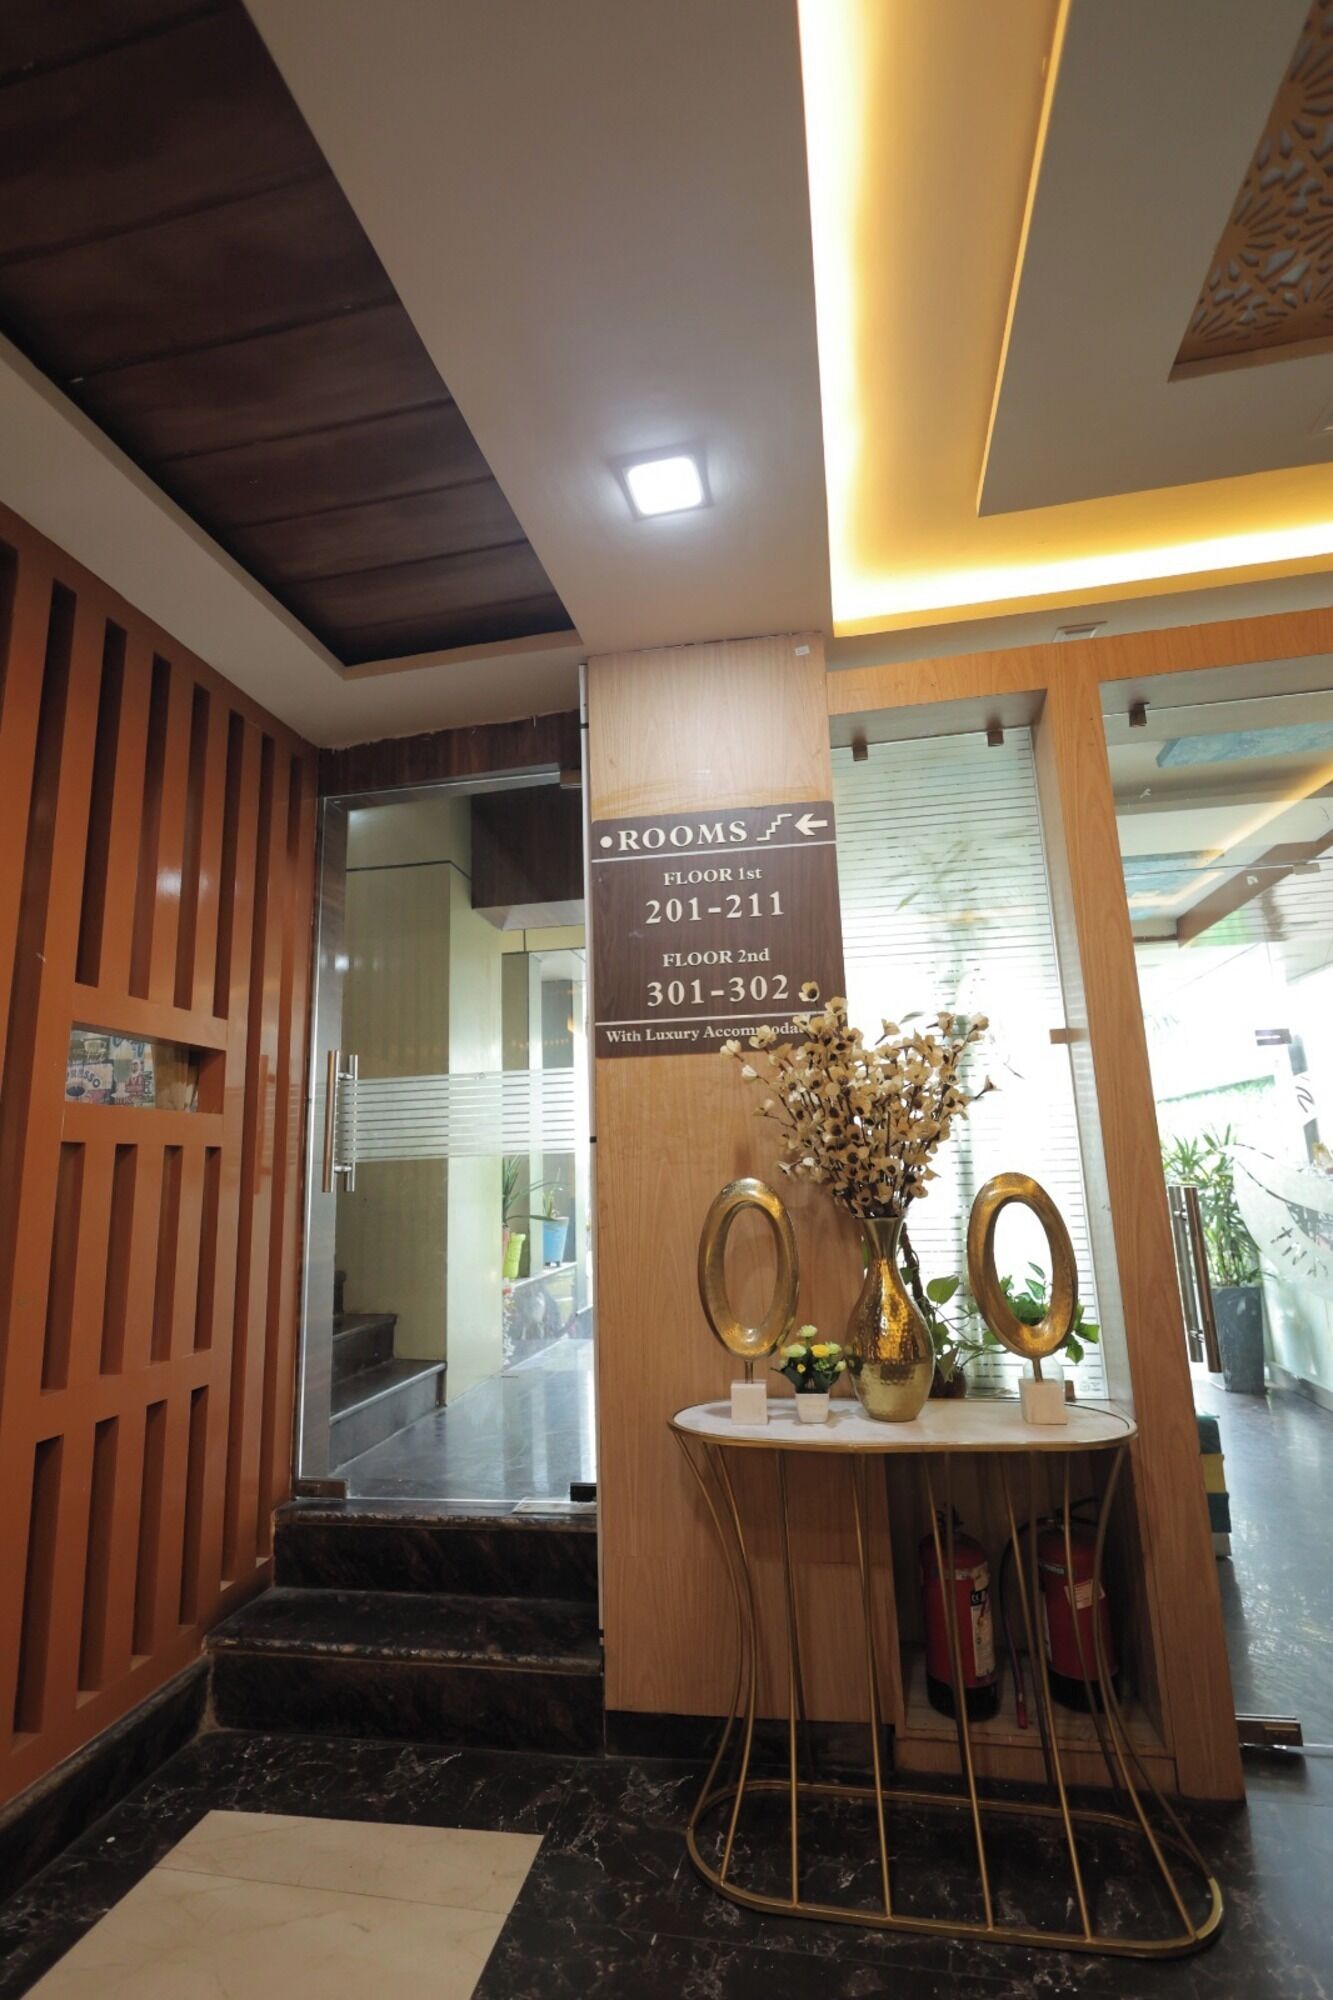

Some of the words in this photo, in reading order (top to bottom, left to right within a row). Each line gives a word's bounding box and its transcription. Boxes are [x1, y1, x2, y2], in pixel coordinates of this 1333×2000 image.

[618, 820, 748, 851] ROOMS
[664, 868, 733, 886] FLOOR
[738, 867, 763, 882] 1st
[645, 891, 785, 924] 201-211
[663, 950, 733, 968] FLOOR
[737, 948, 770, 964] 2nd
[646, 974, 789, 1007] 301-302
[606, 1029, 641, 1044] With
[645, 1027, 700, 1041] Luxury
